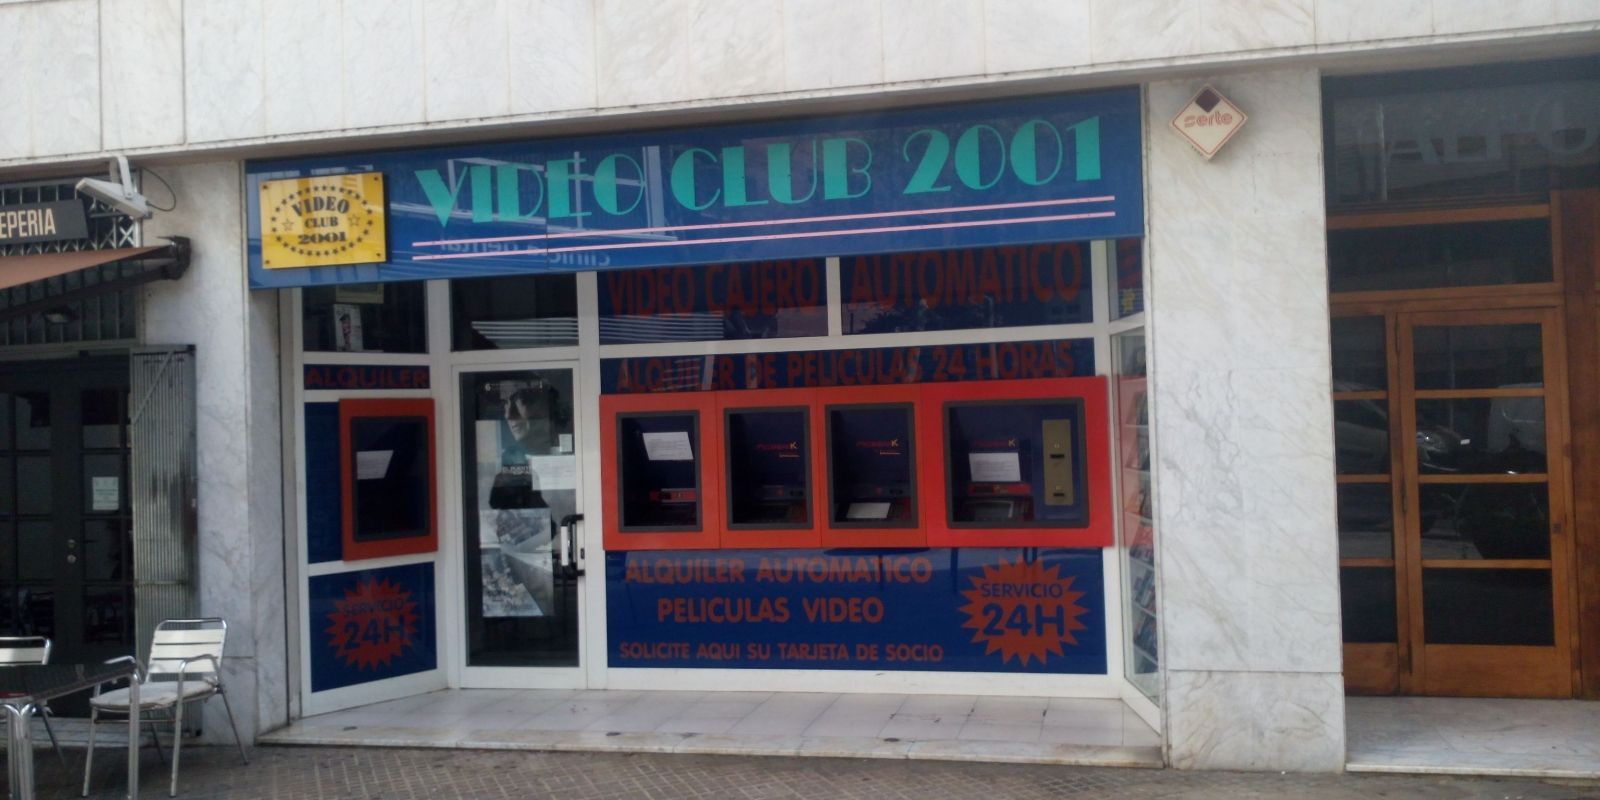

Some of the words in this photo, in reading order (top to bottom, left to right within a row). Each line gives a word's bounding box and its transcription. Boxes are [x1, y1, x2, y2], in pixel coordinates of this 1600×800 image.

[414, 152, 646, 228] VIDEO
[670, 137, 873, 212] CLUB
[902, 115, 1102, 195] 2001
[291, 196, 350, 217] VIDEO
[0, 208, 56, 239] EPERIA
[304, 217, 339, 229] CLUB
[298, 232, 347, 245] 2001
[607, 263, 695, 320] VIDEO
[705, 257, 820, 318] CAJERO
[850, 240, 1082, 310] AUTOMATICO
[305, 366, 429, 389] ALQUILER
[616, 355, 735, 394] ALQUILER
[745, 352, 777, 389] DE
[787, 346, 922, 389] PELICULAS
[932, 345, 966, 382] 24
[975, 338, 1075, 380] HORAS
[625, 557, 745, 584] ALQUILER
[755, 556, 932, 583] AUTOMATICO
[981, 583, 1063, 598] SERVICIO
[657, 598, 790, 623] PELICULAS
[802, 597, 884, 623] VIDEO
[982, 603, 1065, 637] 24H
[343, 615, 406, 650] 24H
[620, 642, 690, 659] SOLICITE
[696, 643, 740, 660] AQUI
[747, 643, 771, 660] SU
[777, 643, 849, 660] TARJETA
[856, 644, 879, 661] DE
[886, 644, 944, 662] SOCIO
